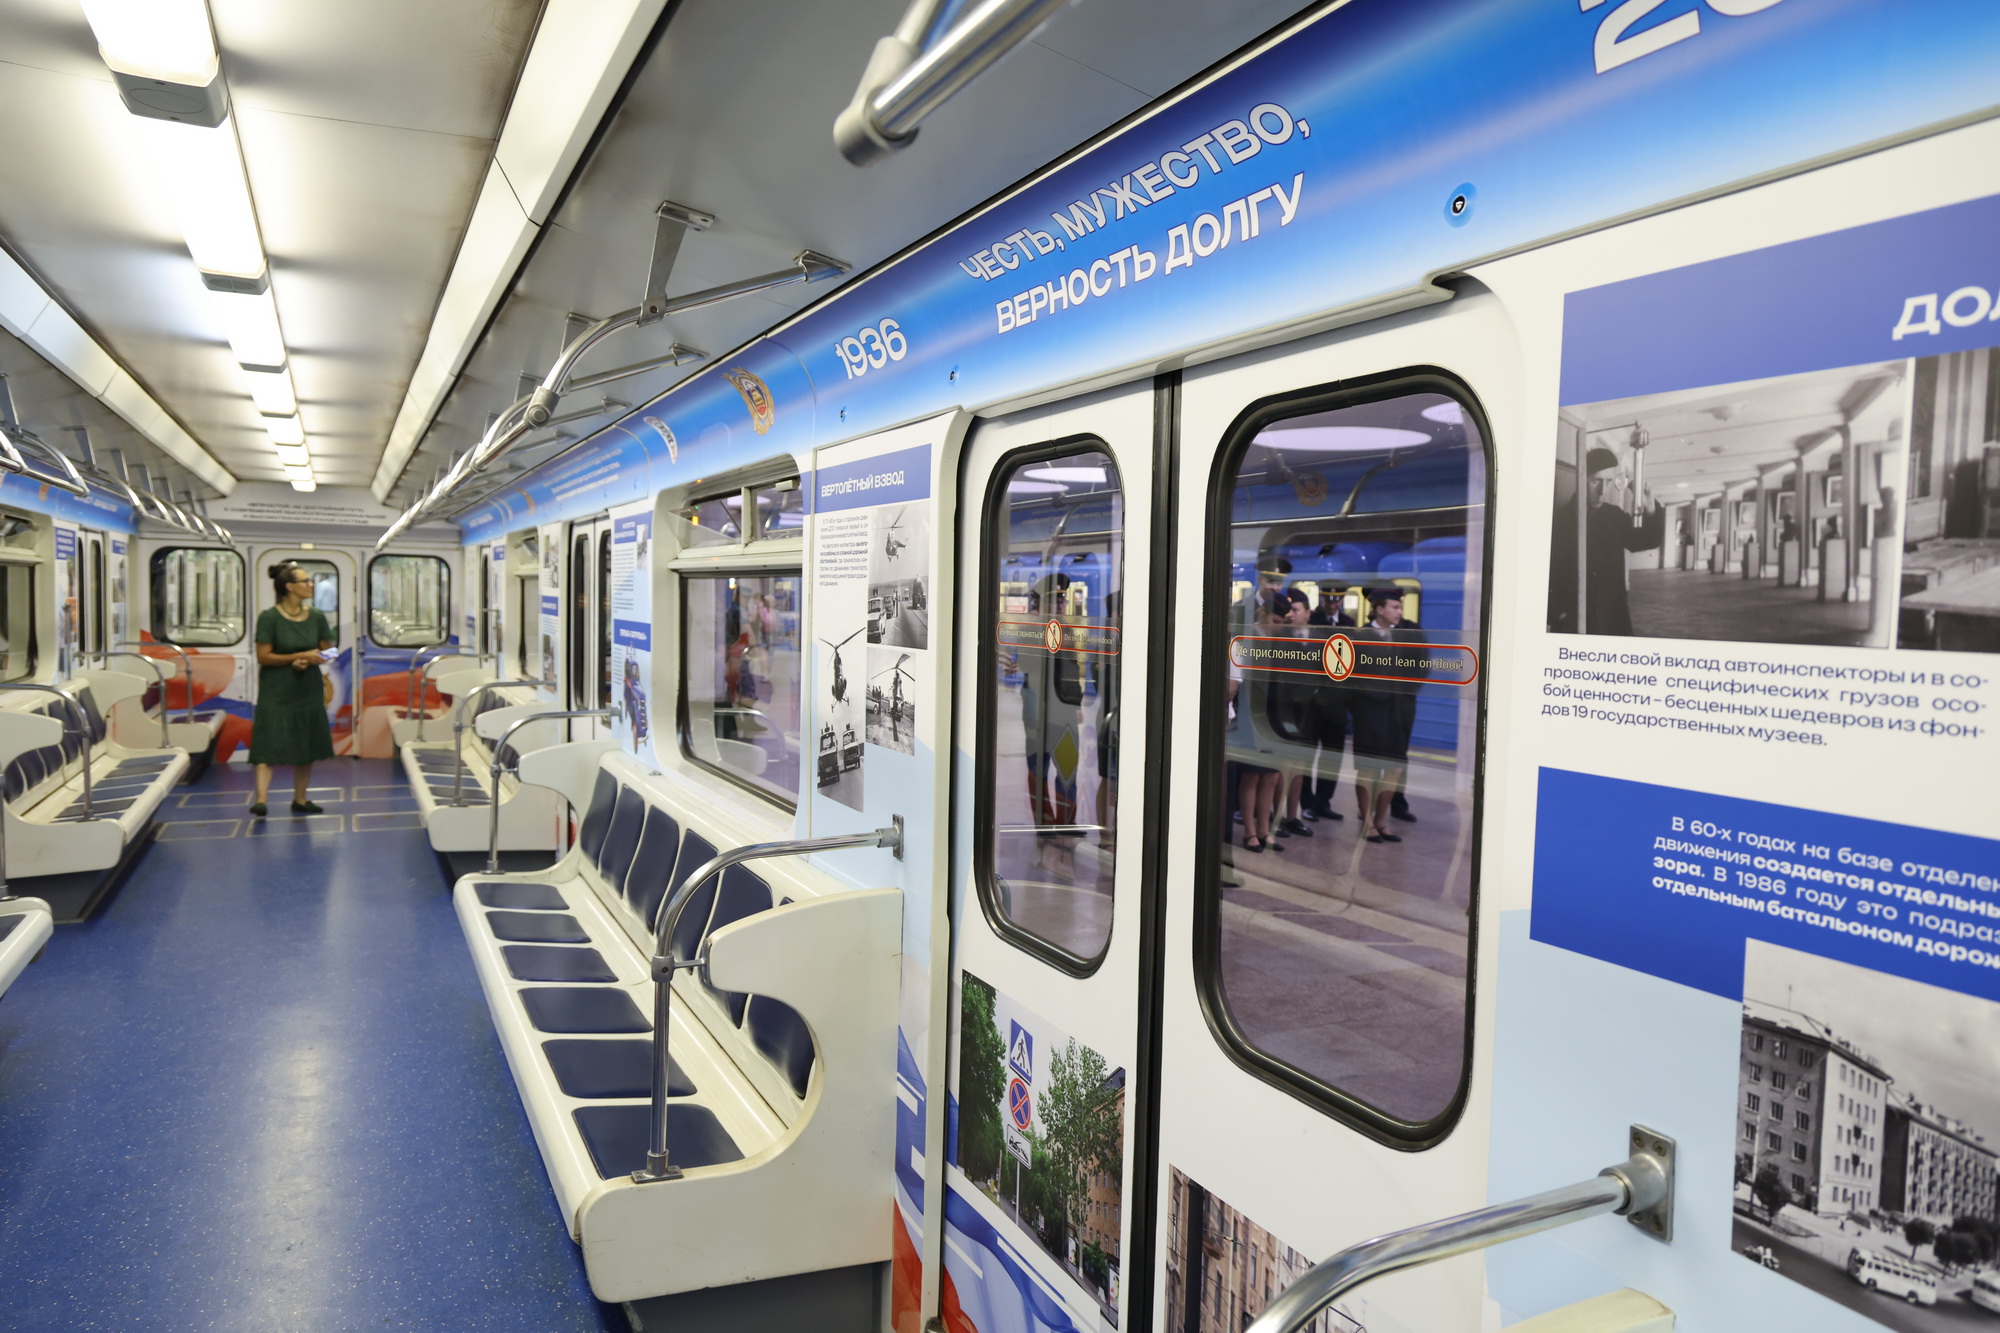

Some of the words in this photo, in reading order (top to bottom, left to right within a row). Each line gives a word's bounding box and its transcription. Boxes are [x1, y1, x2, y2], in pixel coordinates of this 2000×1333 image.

[959, 227, 1065, 282] ЧЕСТЬ,
[1051, 102, 1311, 241] МУЖЕСТВО,
[996, 244, 1156, 334] ВЕРНОСТЬ
[1165, 172, 1305, 276] ДОЛГУ
[1892, 286, 2000, 341] ДО
[834, 317, 908, 380] 1936
[875, 470, 904, 488] ВЗВОД
[1236, 643, 1248, 657] Не
[1249, 647, 1321, 662] прислоняться!
[1360, 653, 1373, 665] Do
[1376, 656, 1392, 667] not
[1395, 655, 1416, 668] lean
[1419, 659, 1432, 669] on
[1436, 657, 1464, 671] door!
[1558, 647, 1617, 664] Внесли
[1620, 652, 1661, 667] свой
[1664, 656, 1721, 673] вклад
[1724, 661, 1906, 685] автоинспекторы
[1911, 673, 1925, 686] и
[1930, 673, 1945, 687] в
[1950, 674, 1989, 690] со-
[1543, 668, 1657, 687] провождение
[1665, 676, 1829, 701] специфических
[1839, 689, 1920, 710] грузов
[1932, 698, 1987, 713] осо-
[1543, 683, 1571, 698] бой
[1573, 687, 1651, 706] ценности
[1664, 695, 1769, 719] бесценных
[1771, 707, 1884, 730] шедевров
[1888, 718, 1916, 733] из
[1920, 718, 1986, 738] фон-
[1541, 703, 1570, 718] дов
[1572, 705, 1589, 719] 19
[1590, 709, 1745, 737] государственных
[1748, 726, 1828, 747] музеев.
[1654, 837, 1751, 866] движения
[1753, 855, 1875, 891] создается
[1671, 816, 1685, 831] В
[1690, 820, 1732, 841] 60-х
[1738, 830, 1796, 854] годах
[1802, 843, 1831, 860] на
[1837, 846, 1894, 873] базе
[1652, 875, 1765, 914] отдельным
[1767, 899, 1914, 949] батальоном
[1653, 854, 1706, 878] зора.
[1713, 866, 1727, 883] В
[1736, 871, 1787, 895] 1986
[1795, 886, 1848, 913] году
[1856, 899, 1899, 921] это
